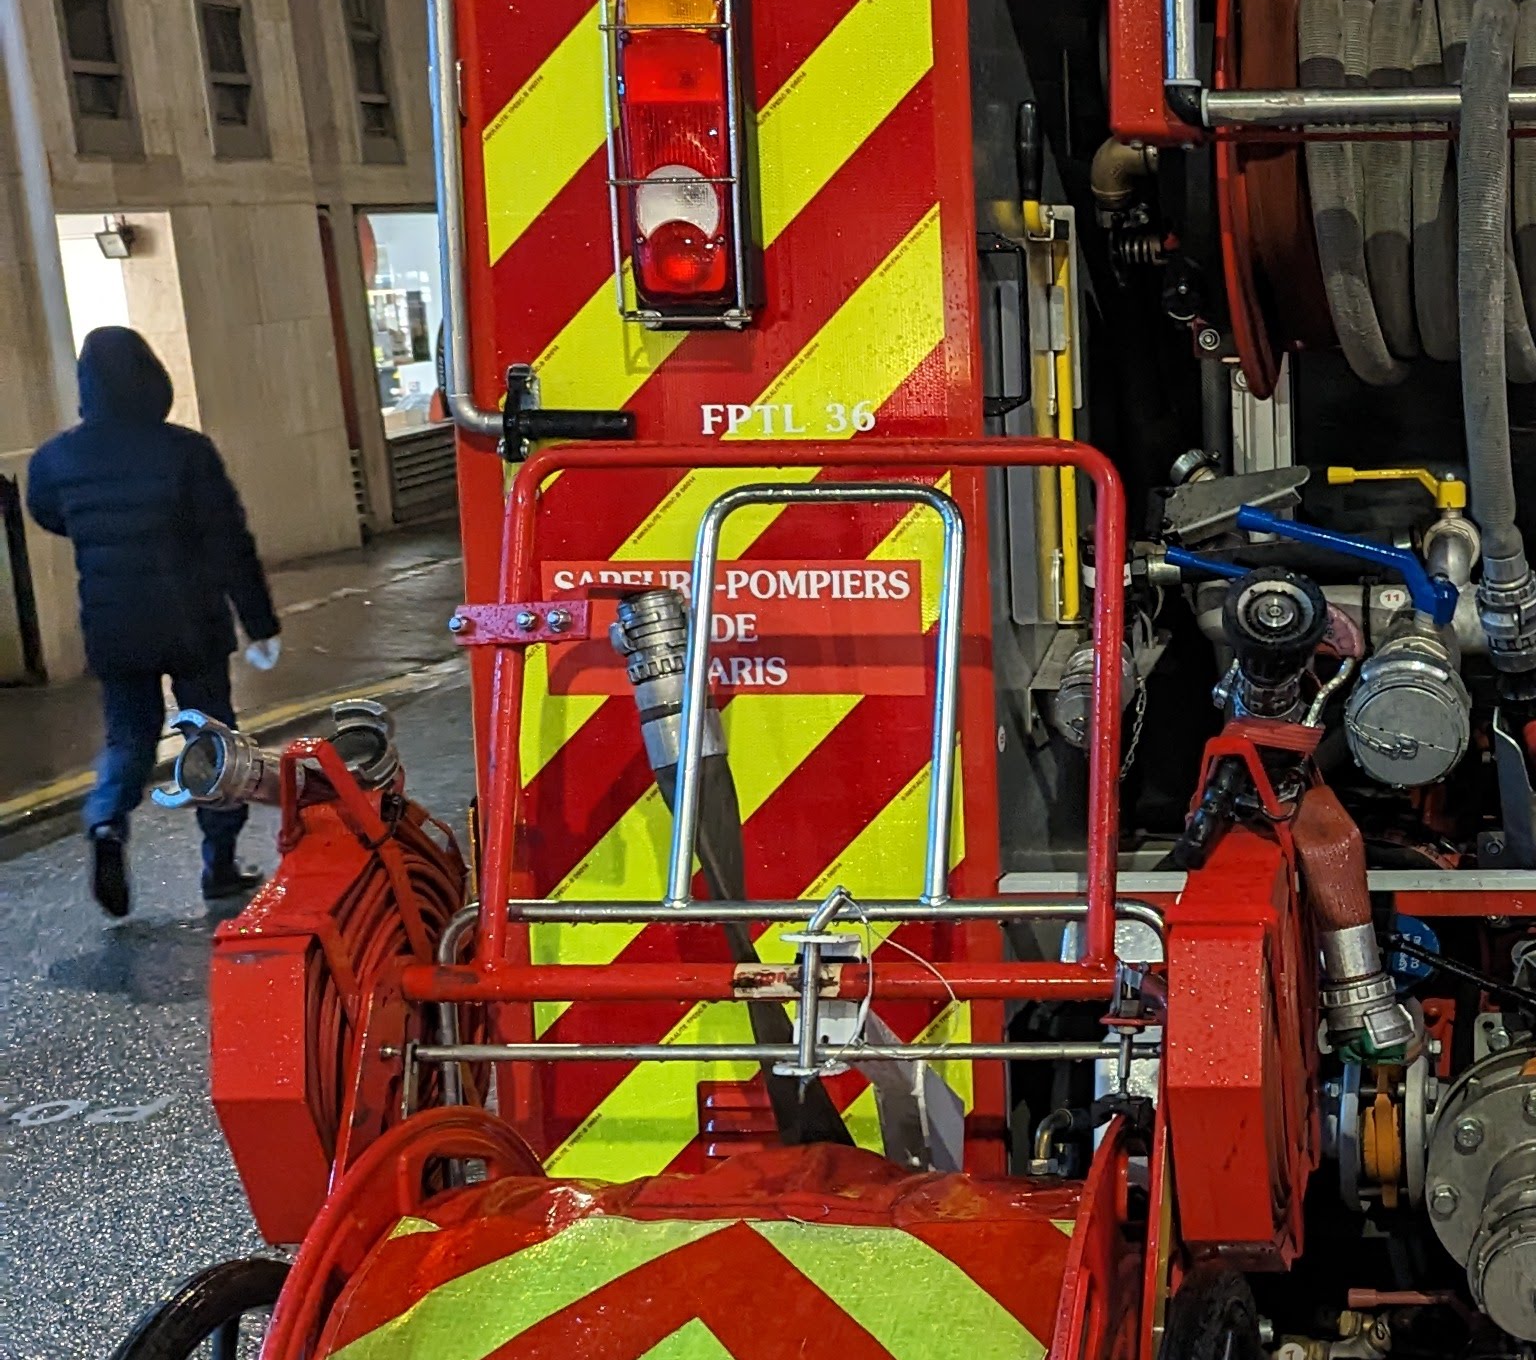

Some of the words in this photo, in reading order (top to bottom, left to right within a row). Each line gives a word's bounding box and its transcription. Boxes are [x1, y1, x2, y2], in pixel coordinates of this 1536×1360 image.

[701, 403, 806, 434] FPTL
[827, 400, 876, 432] 36
[1385, 593, 1400, 602] 11
[711, 612, 758, 643] DE
[707, 657, 789, 686] ARIS
